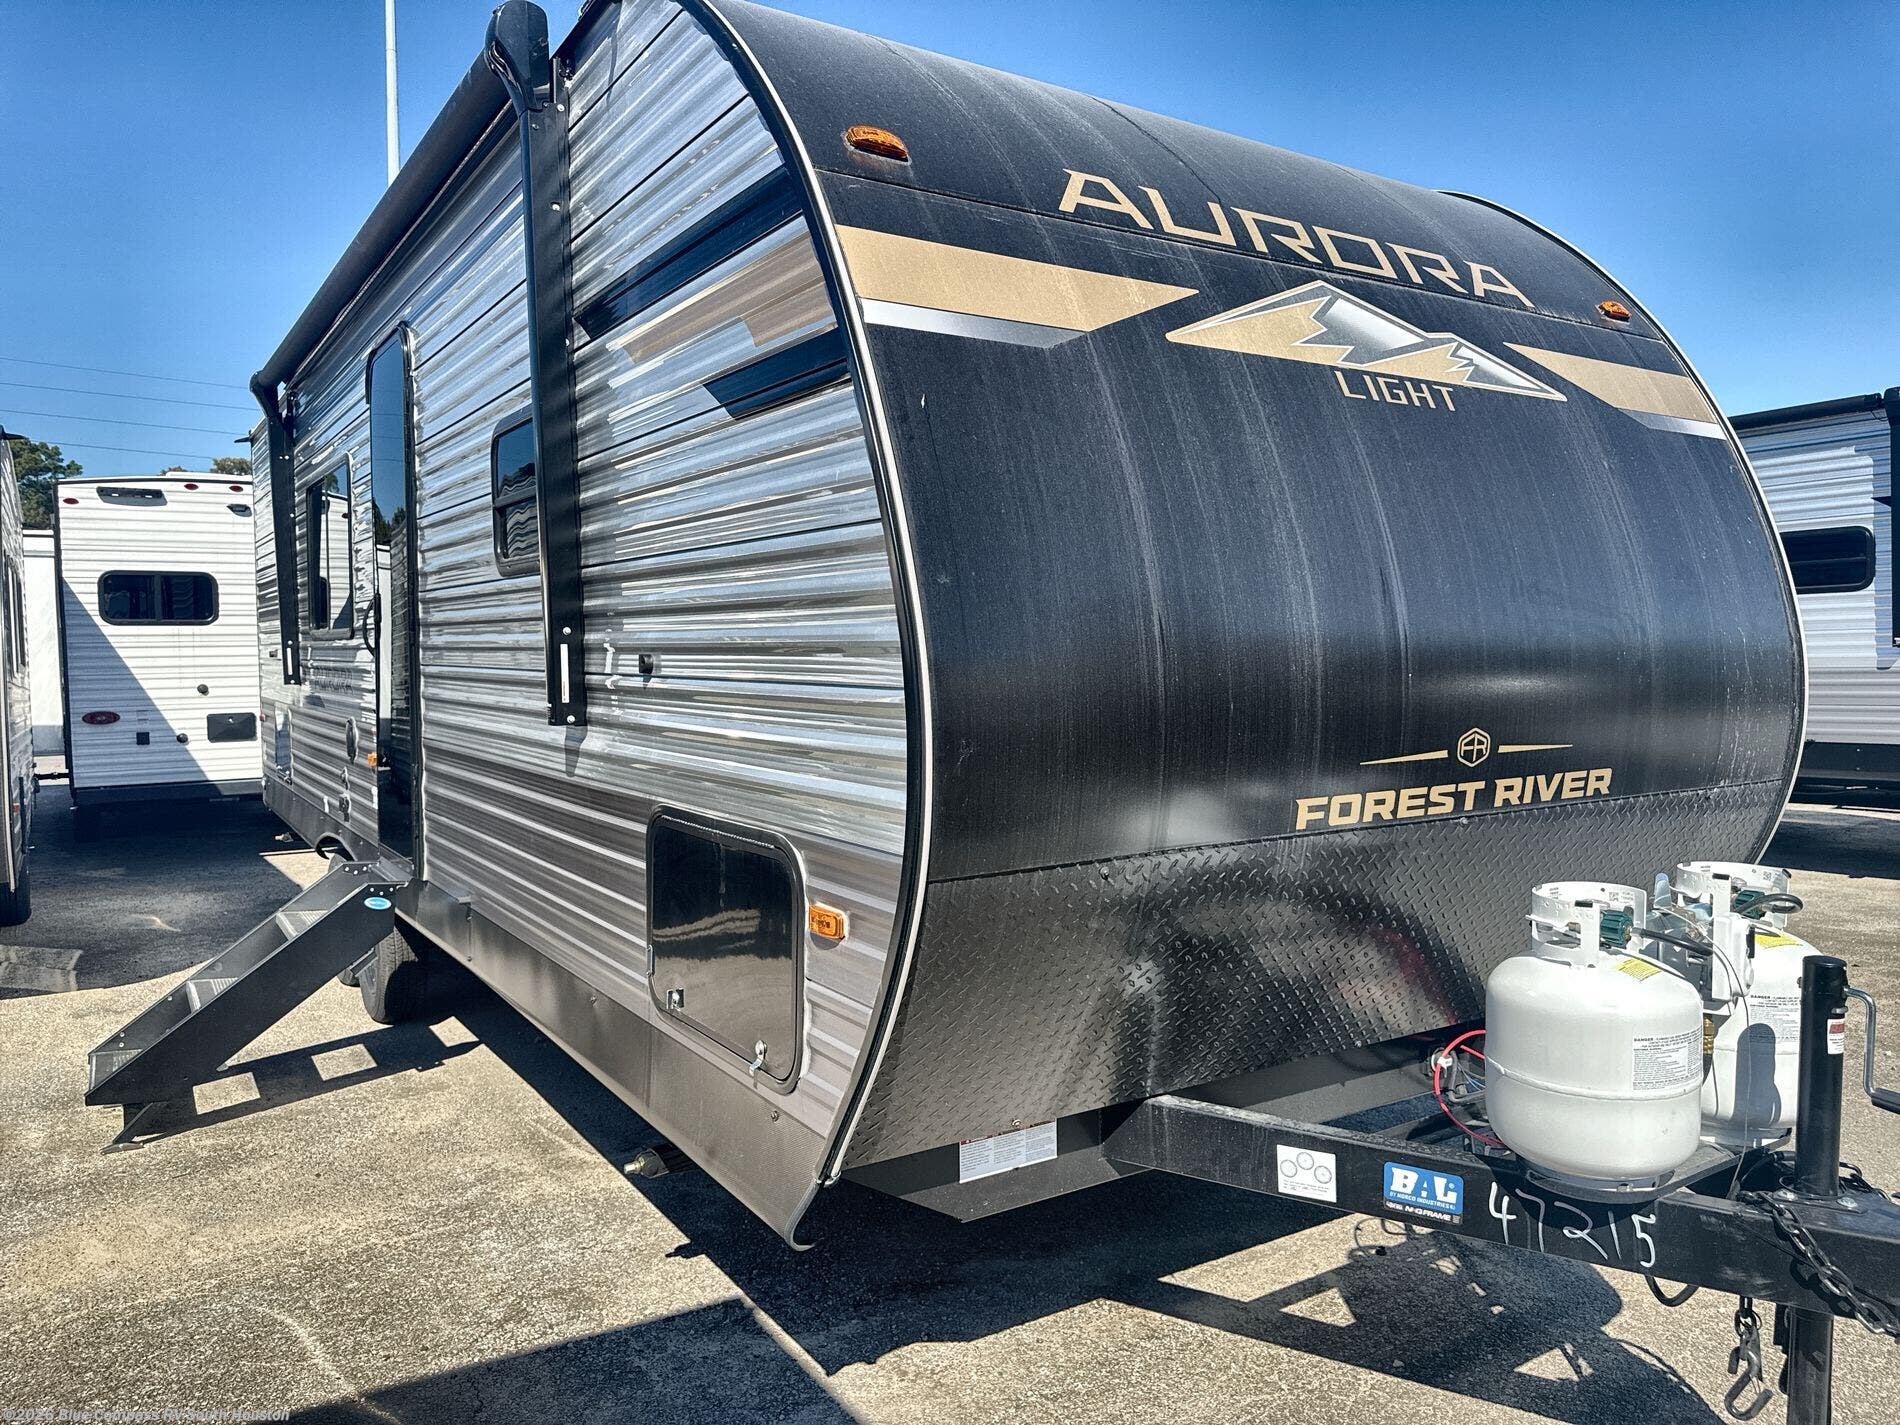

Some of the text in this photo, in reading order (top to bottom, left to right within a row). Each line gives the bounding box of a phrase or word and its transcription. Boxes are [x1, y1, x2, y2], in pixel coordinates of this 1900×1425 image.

[1058, 167, 1535, 308] AURORA
[1333, 370, 1456, 412] LIGHT
[1295, 767, 1613, 830] FOREST RIVER
[1488, 1181, 1657, 1268] 47215
